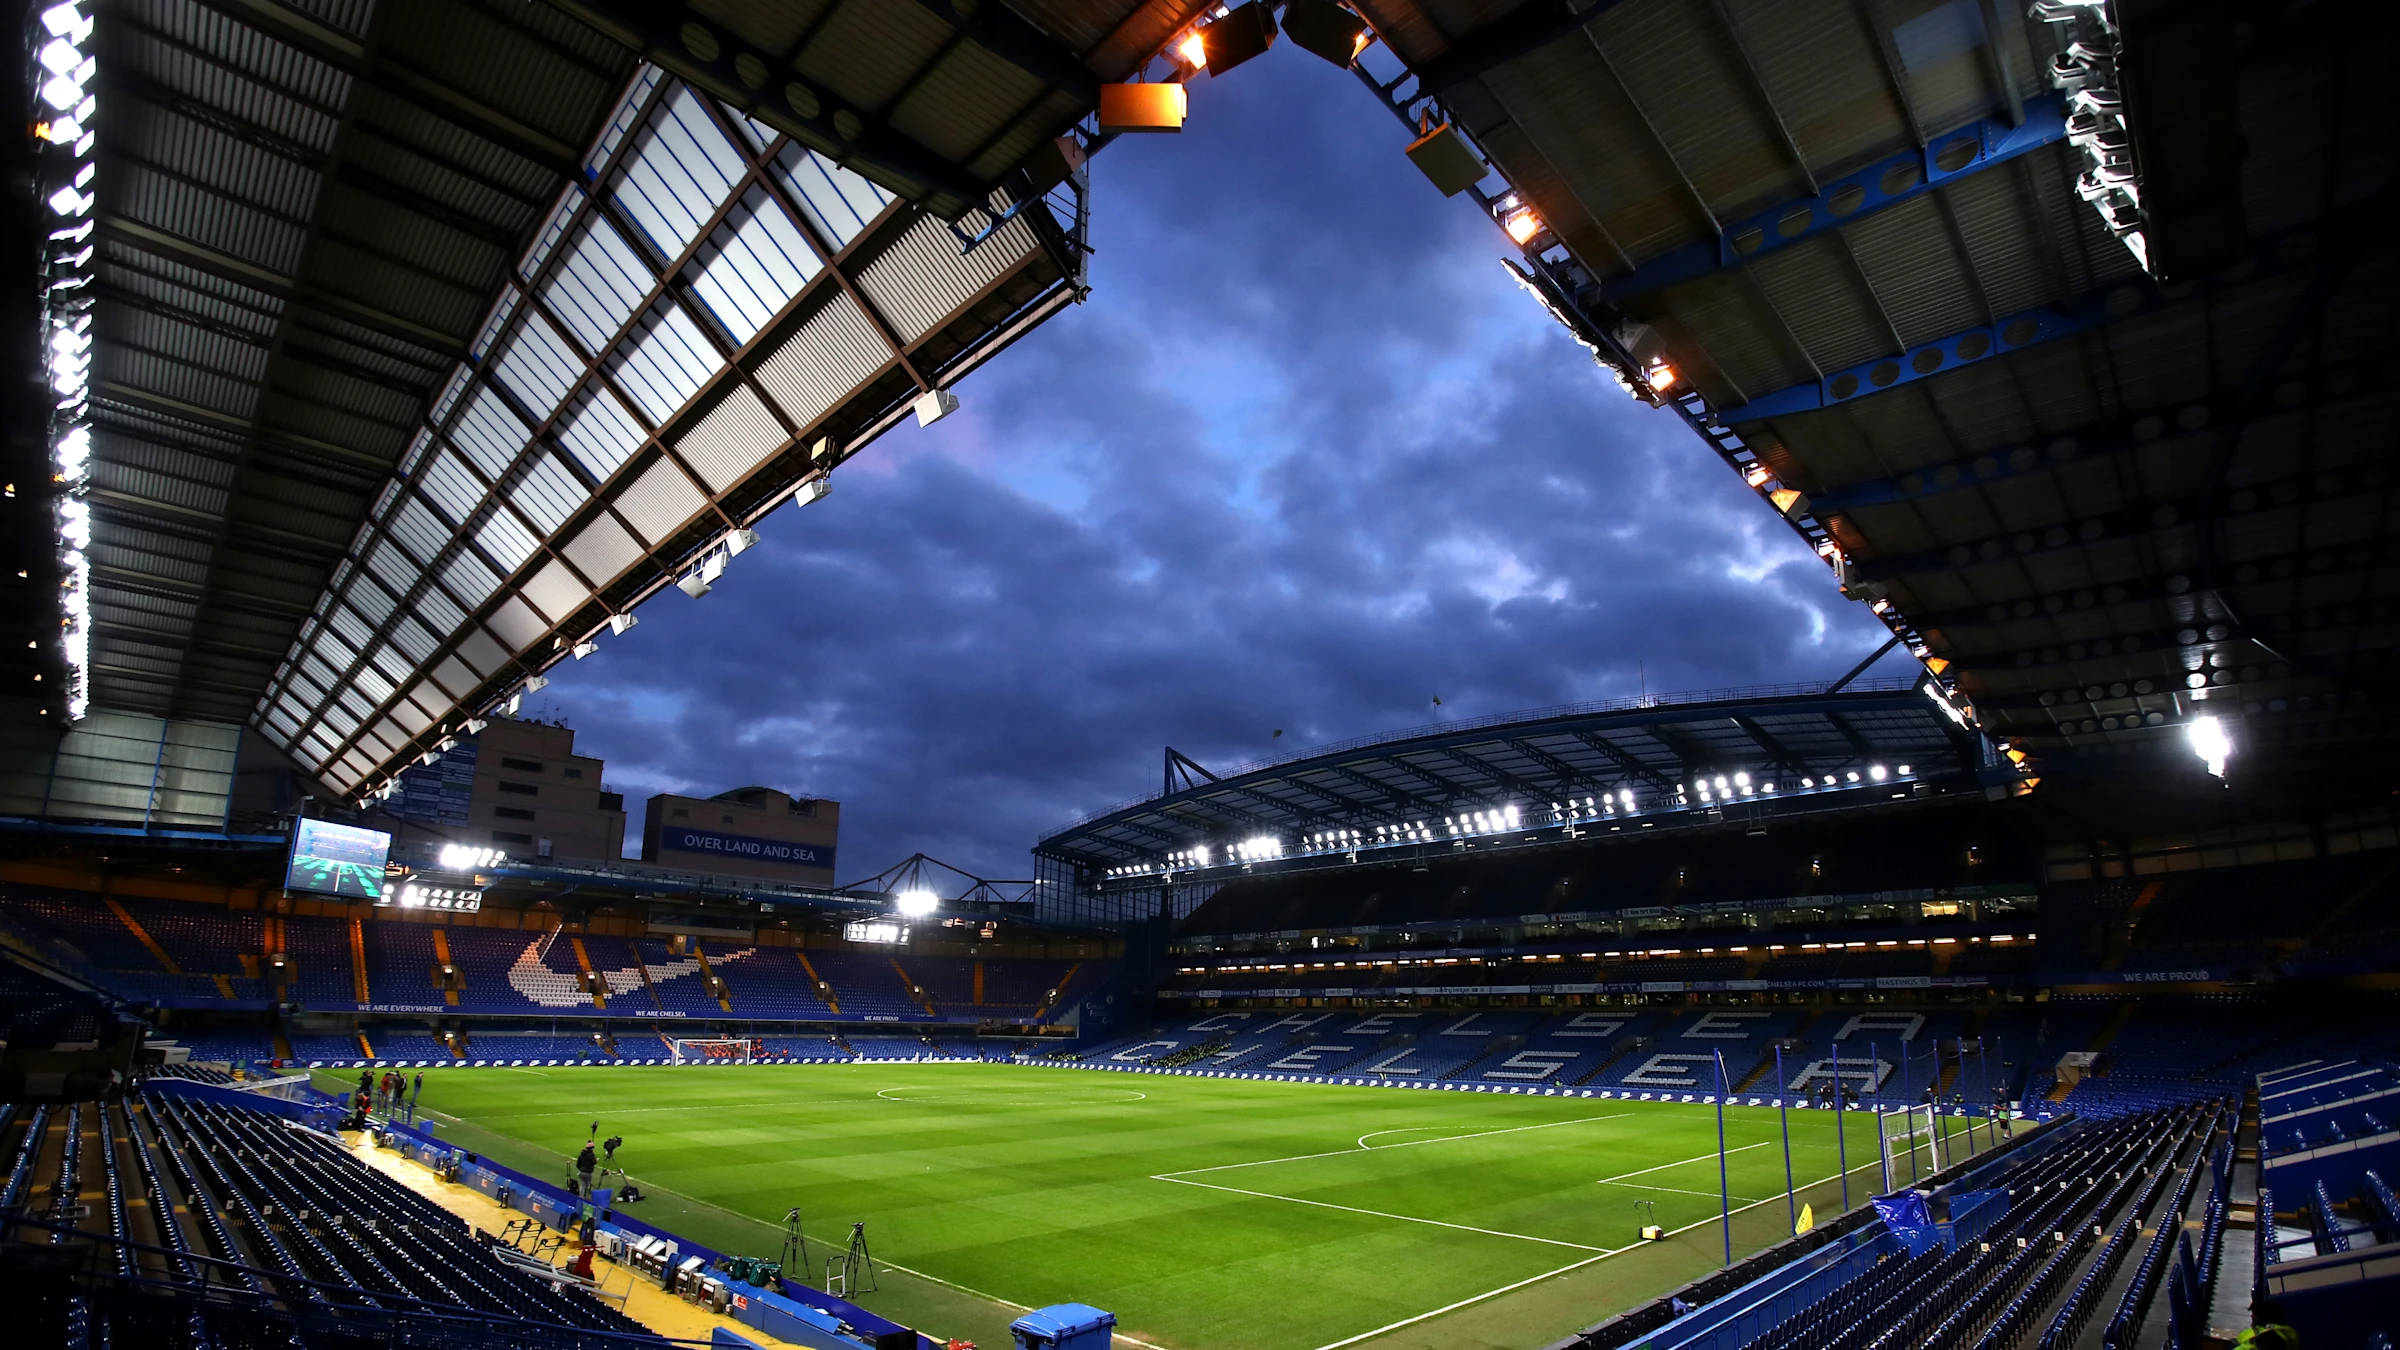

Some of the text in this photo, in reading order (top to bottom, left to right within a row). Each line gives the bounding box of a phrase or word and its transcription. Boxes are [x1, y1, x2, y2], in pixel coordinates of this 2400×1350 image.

[684, 834, 815, 861] OVER LAND AND SEA
[2123, 970, 2209, 982] WE ARE PROUD
[372, 1004, 389, 1012] ARE
[390, 1005, 444, 1013] EVERYWHERE
[1187, 1012, 1926, 1041] CHELSEA
[1110, 1041, 1894, 1093] CHELSEA
